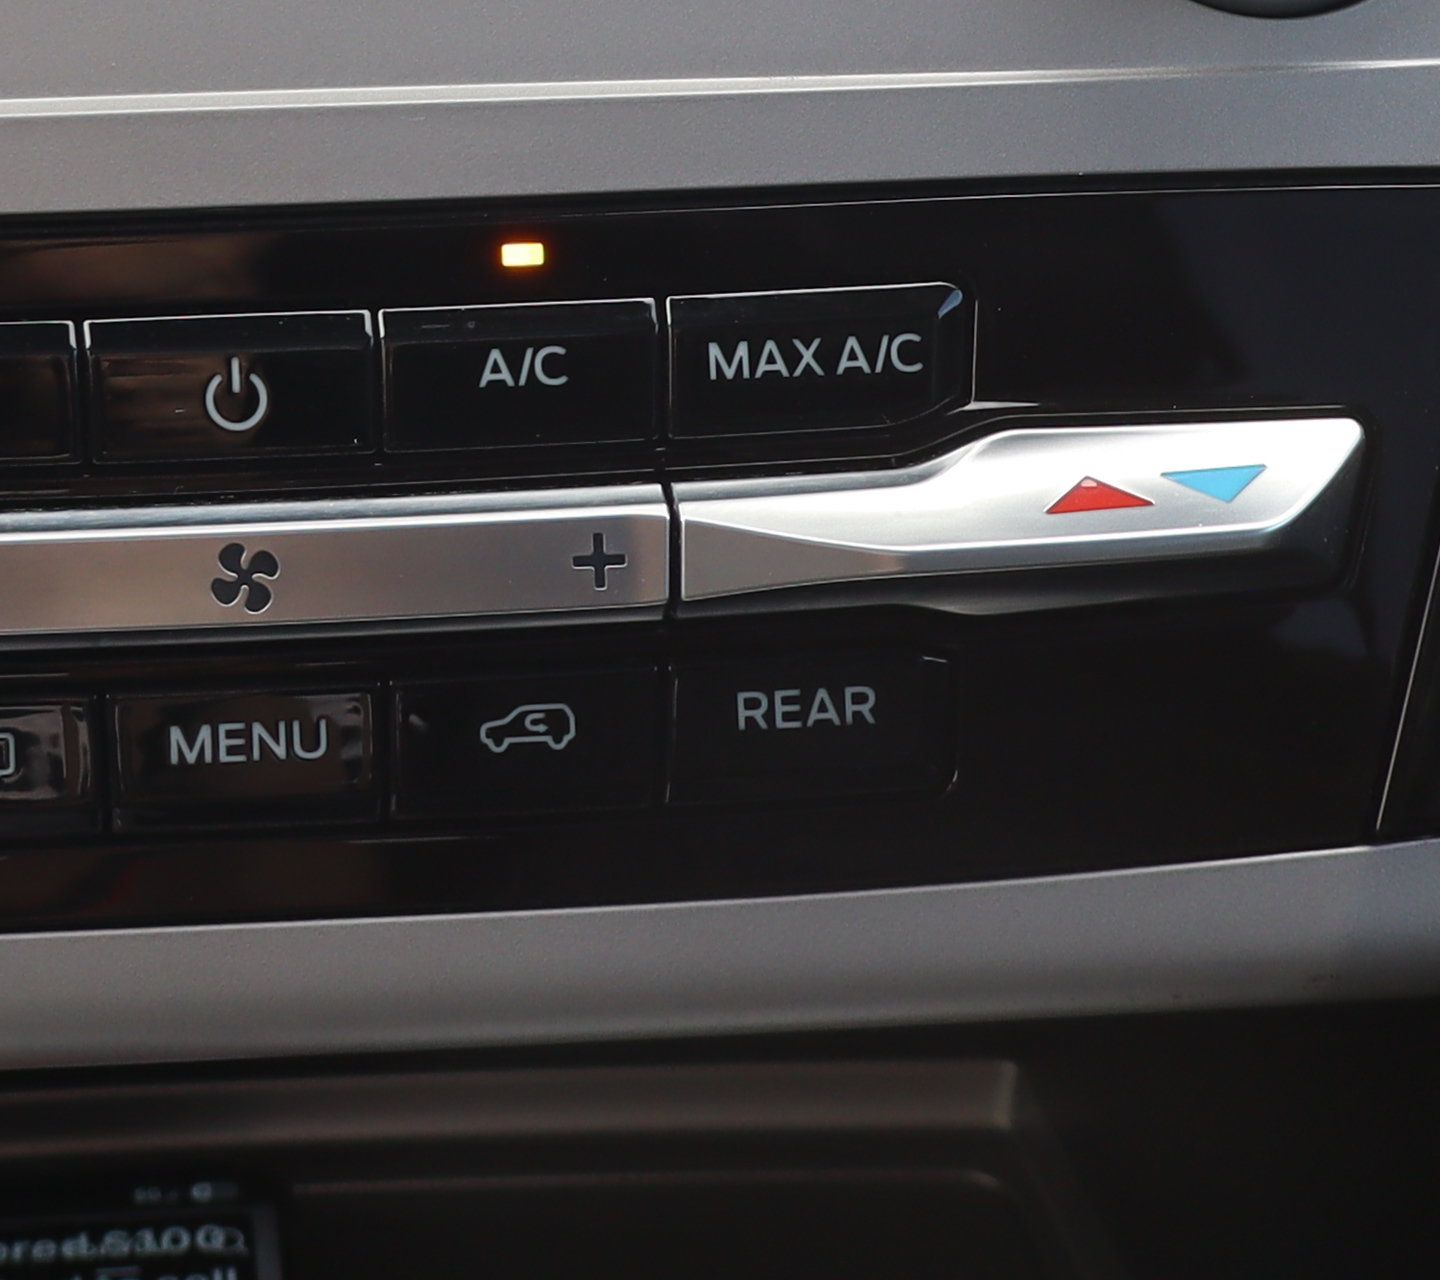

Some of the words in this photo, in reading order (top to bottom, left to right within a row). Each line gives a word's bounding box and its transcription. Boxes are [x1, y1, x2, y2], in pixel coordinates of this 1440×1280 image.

[479, 344, 569, 388] A/C
[707, 338, 825, 381] MAX
[837, 333, 924, 376] A/C
[735, 686, 877, 731] REAR
[169, 718, 329, 765] MENU
